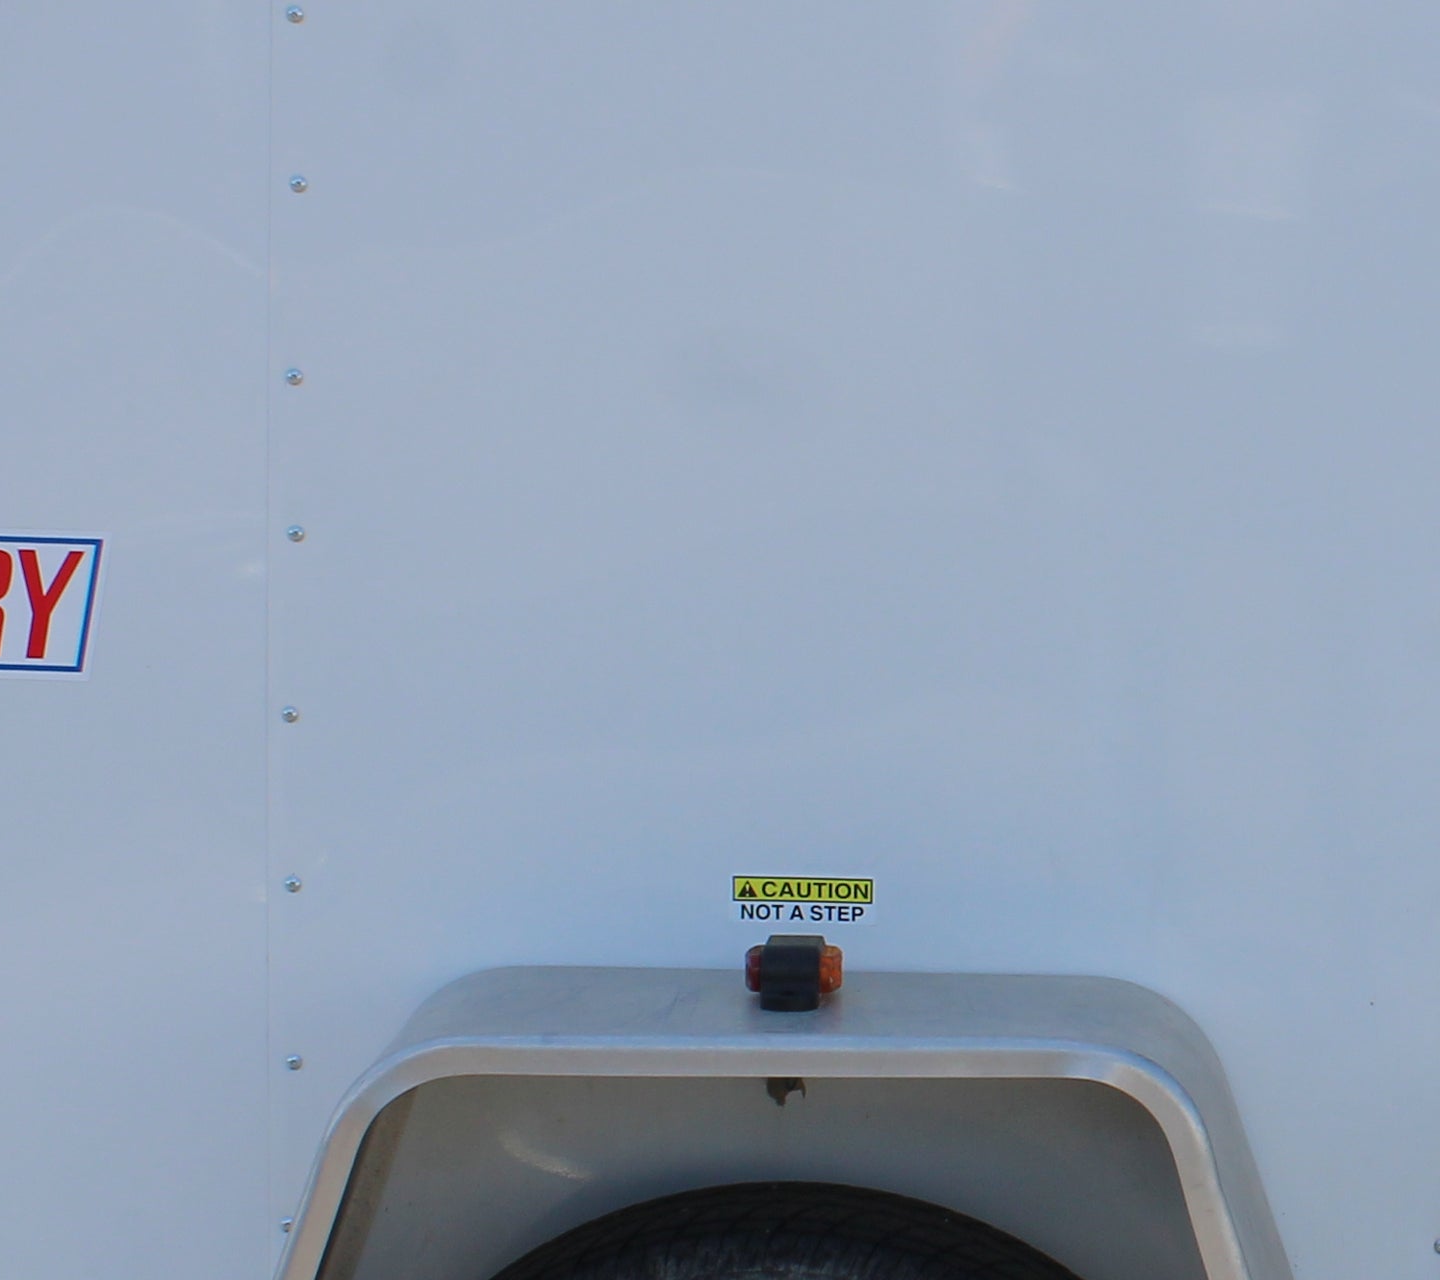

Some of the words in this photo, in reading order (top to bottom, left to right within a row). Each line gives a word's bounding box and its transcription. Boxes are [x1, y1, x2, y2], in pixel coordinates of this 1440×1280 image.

[761, 881, 869, 899] CAUTION
[740, 904, 784, 920] NOT
[790, 905, 804, 920] A
[810, 906, 864, 921] STEP
